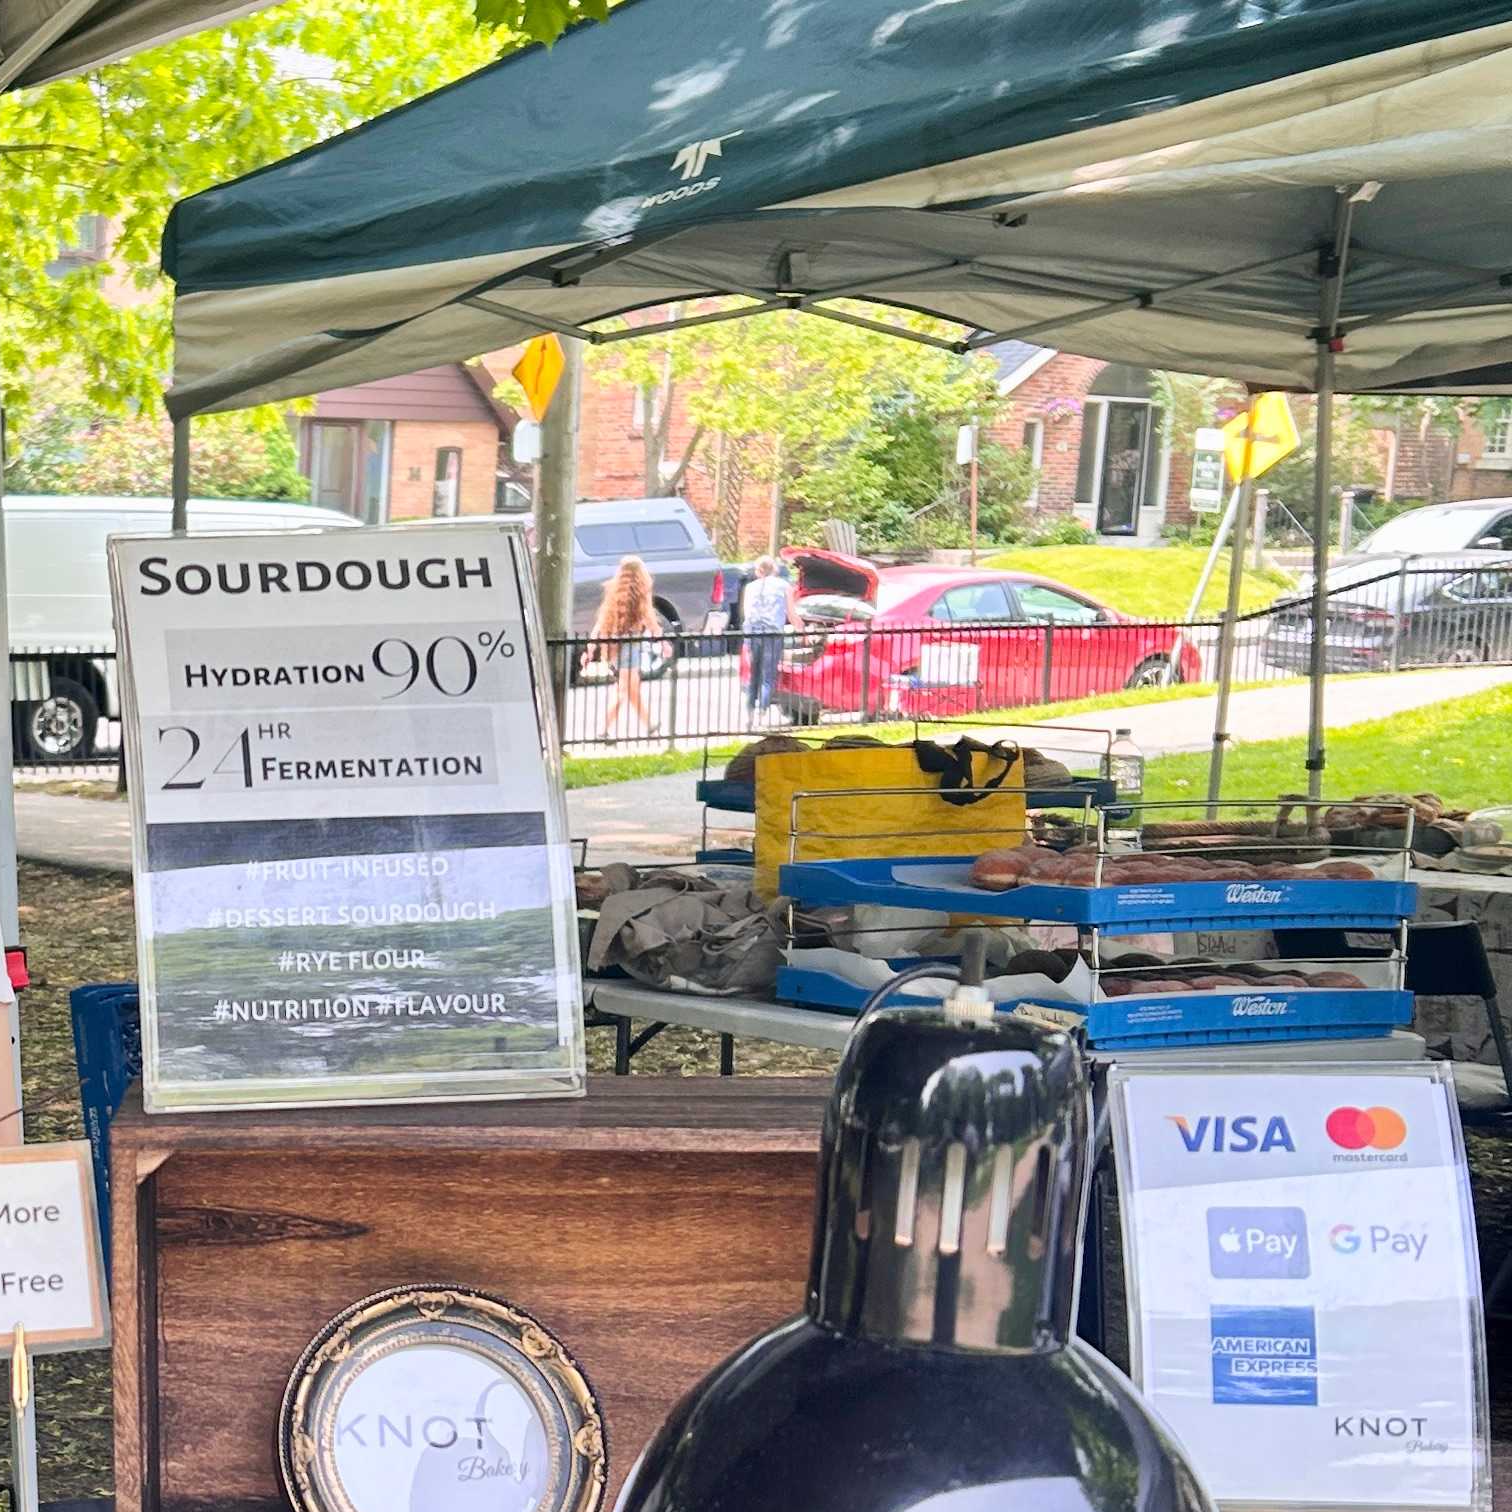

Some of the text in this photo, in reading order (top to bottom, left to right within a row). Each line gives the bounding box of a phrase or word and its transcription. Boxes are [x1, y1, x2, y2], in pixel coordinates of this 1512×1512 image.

[139, 556, 493, 595] SOURDOUGH
[185, 664, 365, 688] HYDRATION
[261, 756, 483, 781] FERMENTATION
[1225, 883, 1281, 904] Weston
[207, 902, 497, 928] #DESSERT SOURDOUGH
[278, 949, 426, 973] #RYE FLOUR
[212, 993, 506, 1021] #NUTRITION #FLAVOUR
[1232, 995, 1287, 1017] Weston
[1164, 1115, 1408, 1162] VISA mastercard
[1245, 1228, 1297, 1258] Pay
[1370, 1225, 1429, 1262] Pay
[1, 1272, 64, 1295] Free
[1212, 1339, 1309, 1354] AMERICAN
[336, 1414, 493, 1449] KNOT
[1334, 1416, 1428, 1438] KNOT
